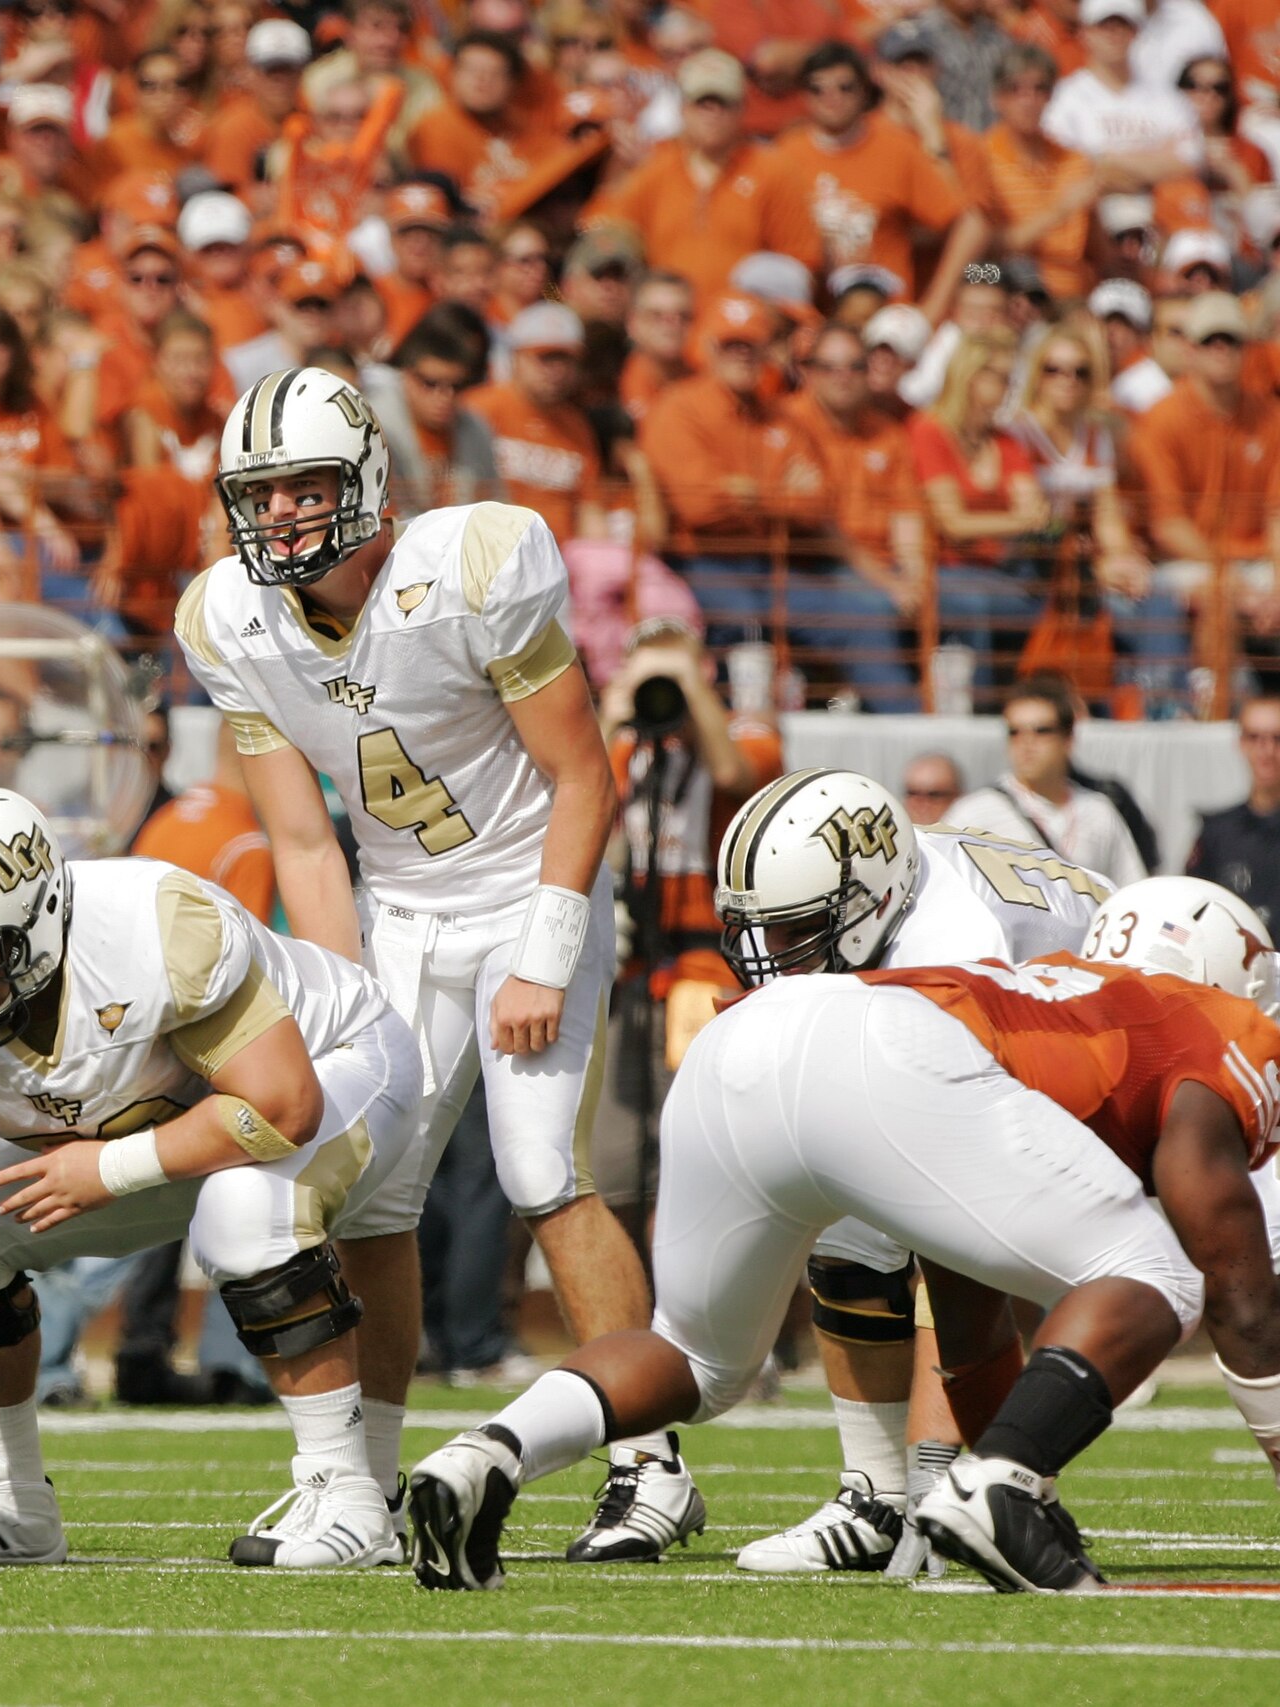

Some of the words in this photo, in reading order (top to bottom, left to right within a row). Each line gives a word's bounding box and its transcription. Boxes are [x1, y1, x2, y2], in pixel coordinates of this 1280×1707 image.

[318, 674, 376, 715] UCF
[357, 726, 477, 857] 4
[808, 802, 899, 865] UCF
[387, 907, 415, 921] adidas
[1086, 911, 1139, 960] 33
[24, 1092, 82, 1127] UCF
[1011, 1470, 1034, 1487] NIKE
